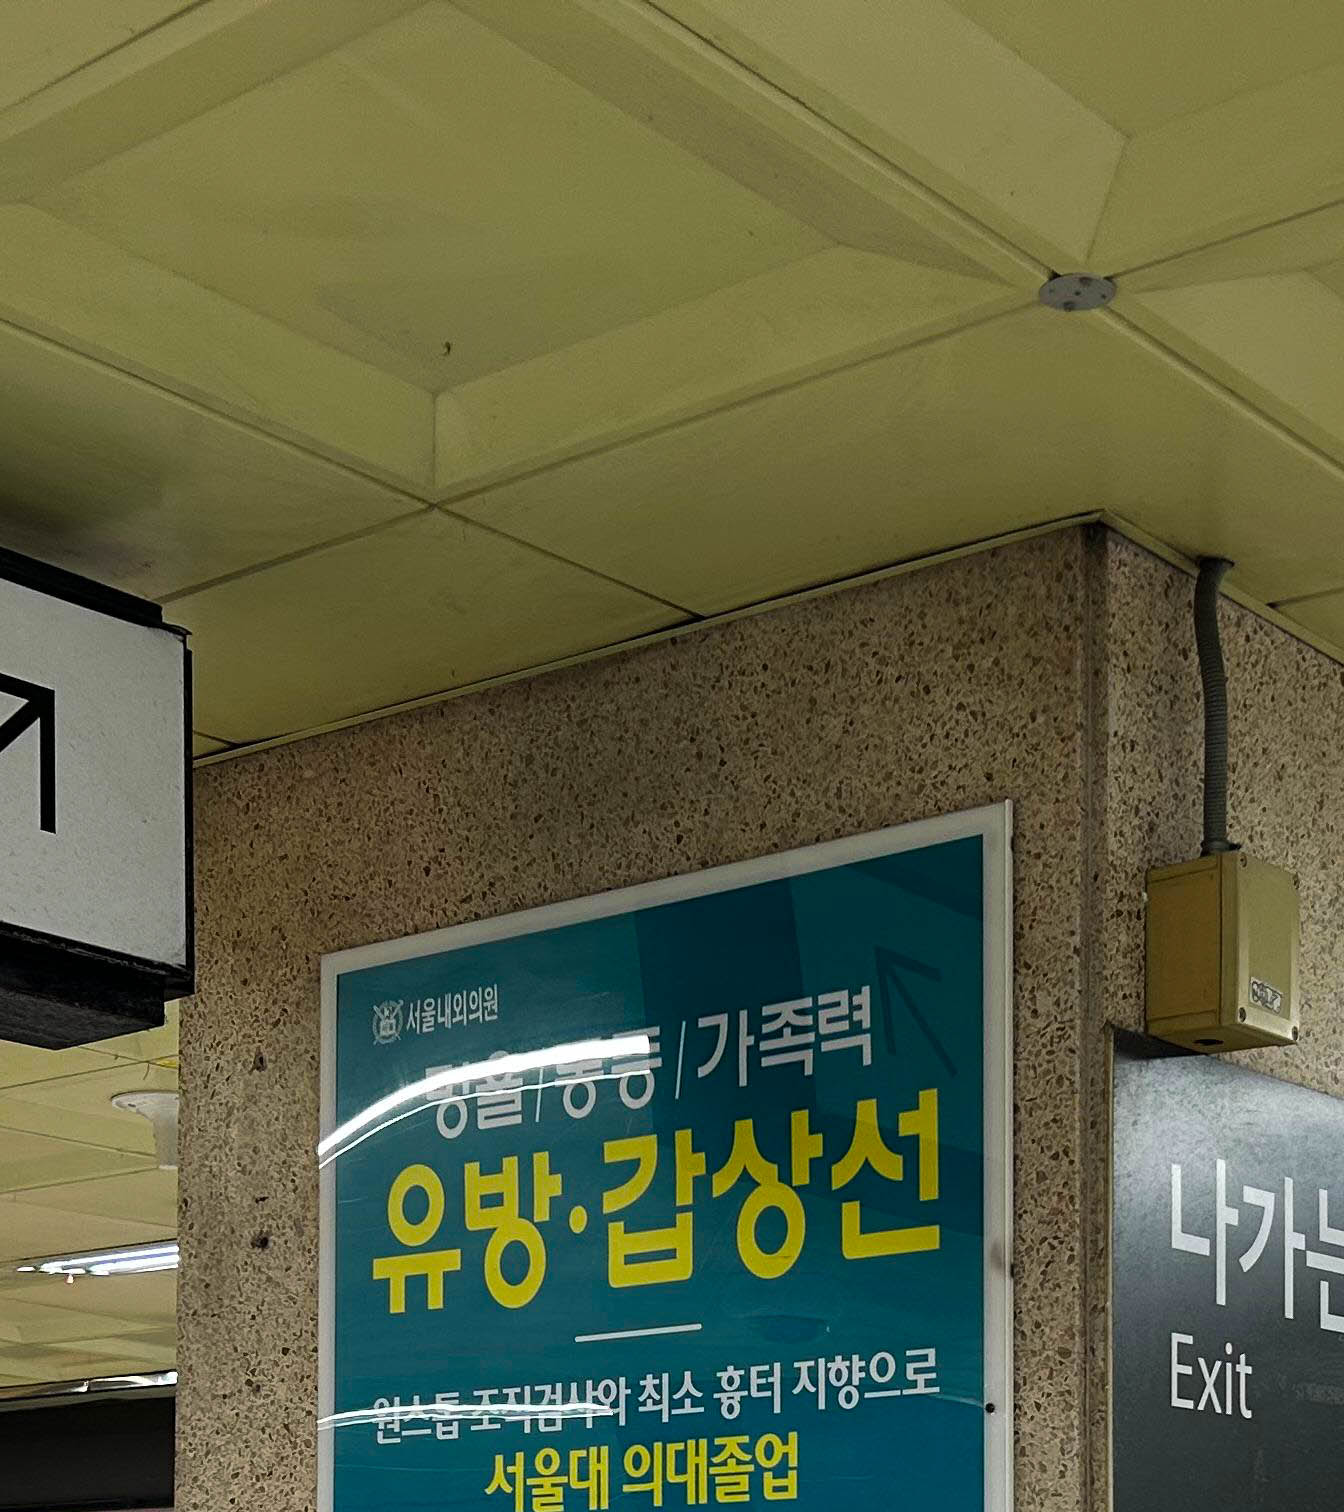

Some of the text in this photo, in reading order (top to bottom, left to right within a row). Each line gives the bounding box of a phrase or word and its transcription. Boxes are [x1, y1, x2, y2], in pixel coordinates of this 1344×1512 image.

[406, 984, 499, 1034] 서울내외의원
[696, 985, 872, 1089] 가족력
[638, 1375, 705, 1422] 최소
[713, 1360, 782, 1420] 흉터
[792, 1348, 940, 1411] 지향으로
[1170, 1332, 1253, 1419] Exit
[622, 1431, 799, 1508] 의대졸업
